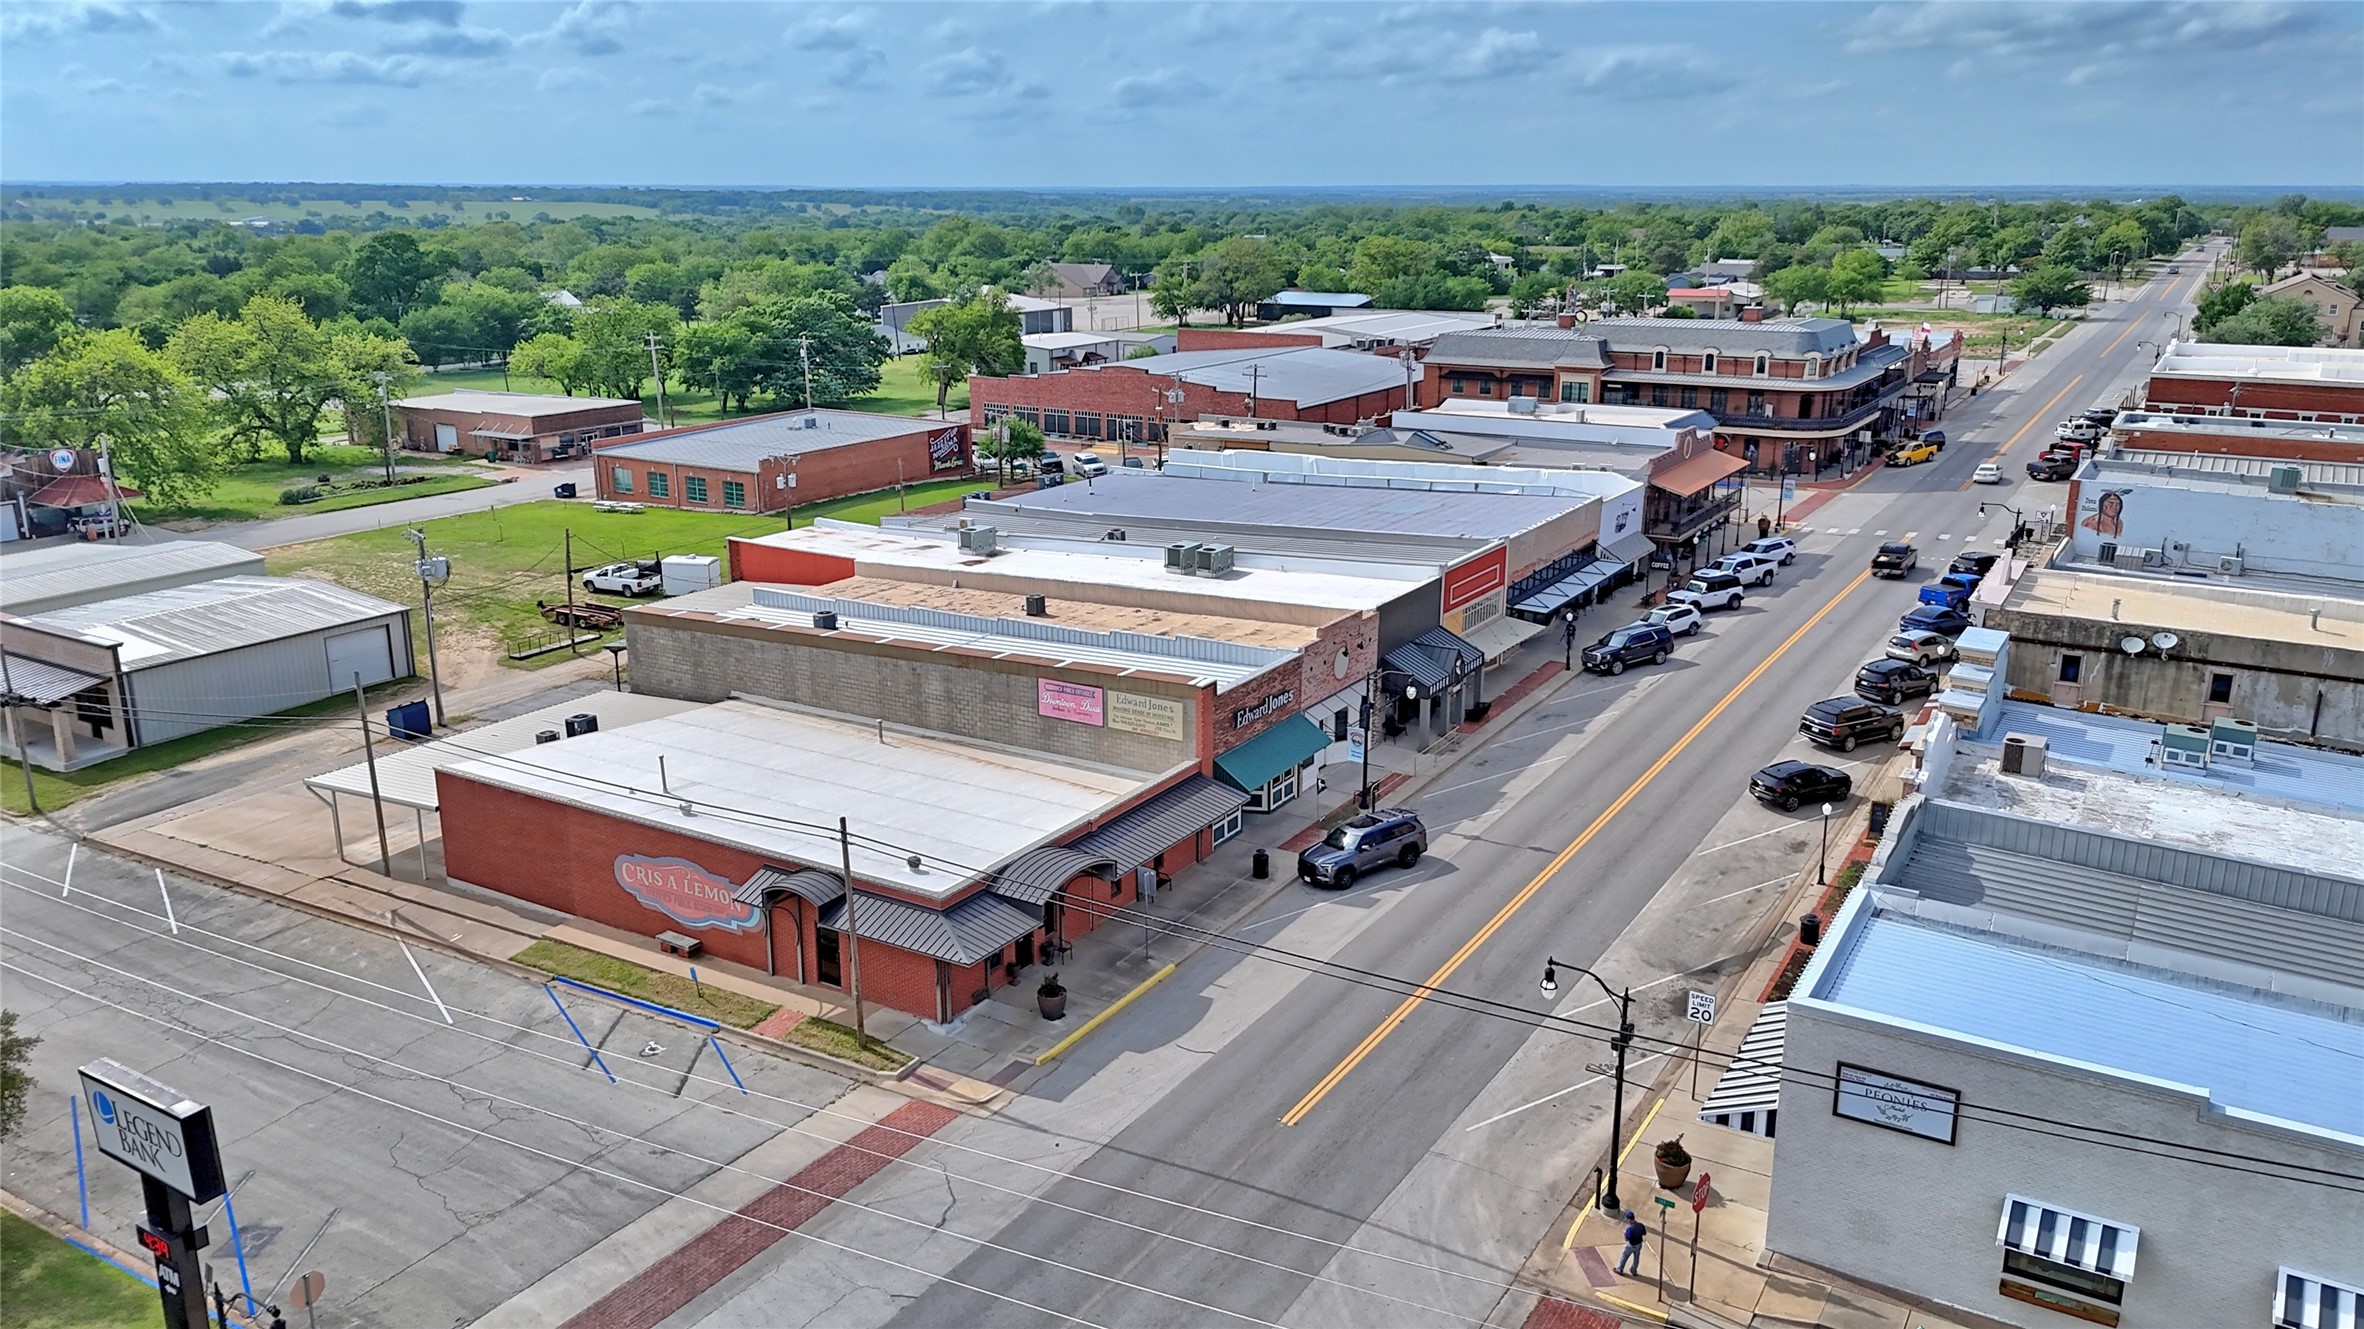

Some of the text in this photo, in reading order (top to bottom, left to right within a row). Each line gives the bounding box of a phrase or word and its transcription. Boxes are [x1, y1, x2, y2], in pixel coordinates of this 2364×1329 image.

[54, 454, 71, 464] FINA
[1651, 561, 1669, 570] COFFEE
[1041, 691, 1076, 709] Downtown
[1080, 698, 1101, 713] Divas
[1116, 693, 1175, 713] Edward Jones
[1235, 690, 1294, 729] Edward Jones
[621, 862, 743, 912] CRIS A LEMON
[1691, 993, 1714, 1004] SPEED
[1692, 1000, 1711, 1010] LIMIT
[1690, 1007, 1712, 1022] 20
[1865, 1088, 1928, 1112] PEONIES
[112, 1100, 182, 1158] LEGEND
[120, 1127, 167, 1173] BANK
[1693, 1181, 1710, 1206] STOP
[159, 1263, 180, 1288] ATM
